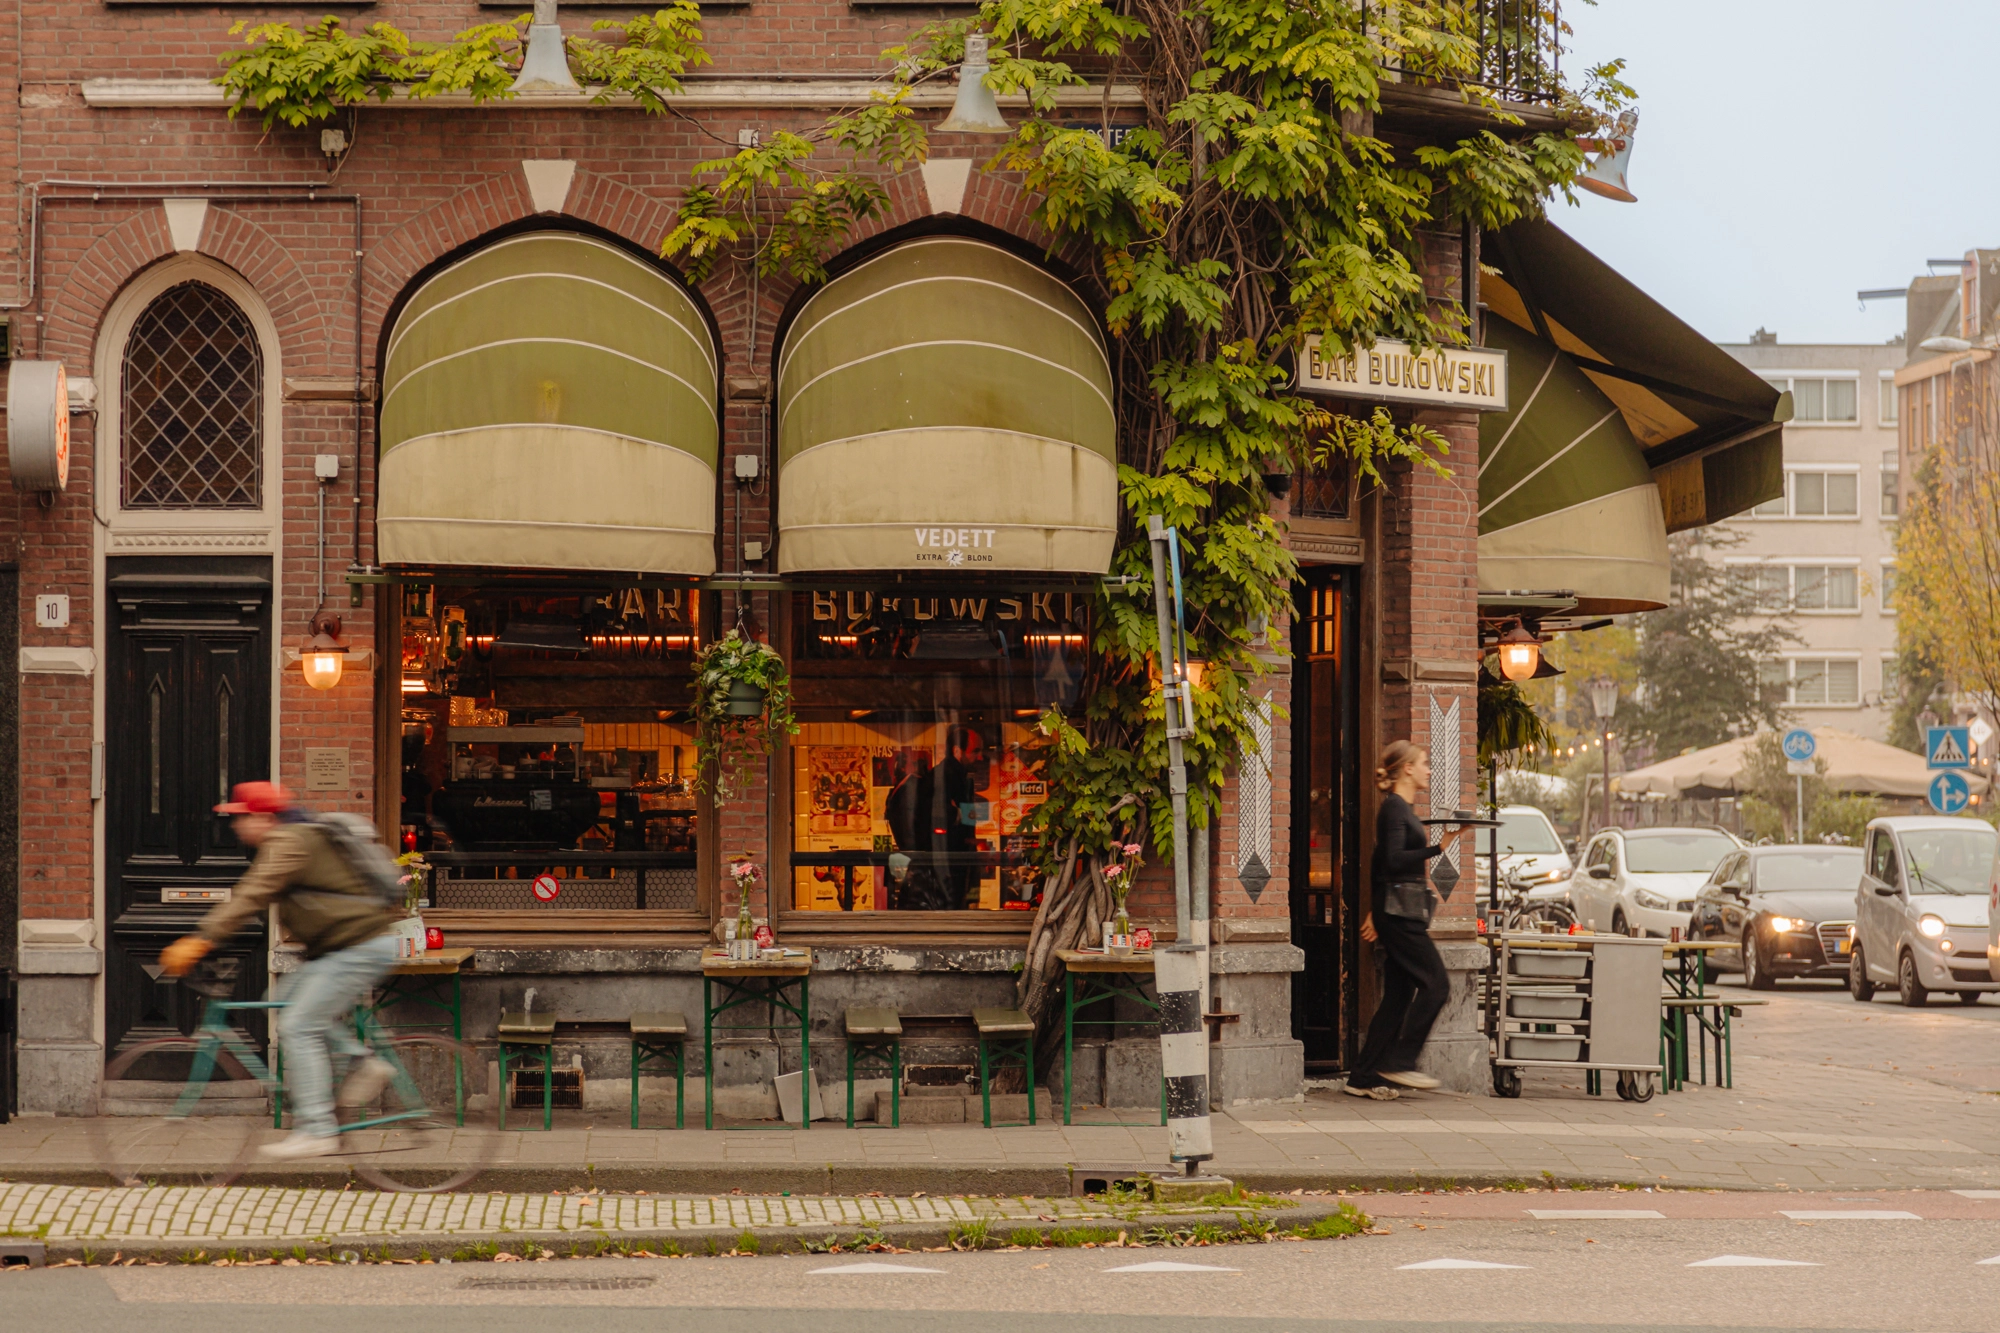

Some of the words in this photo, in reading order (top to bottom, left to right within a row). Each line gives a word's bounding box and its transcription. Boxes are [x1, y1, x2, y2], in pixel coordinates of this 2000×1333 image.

[1309, 345, 1358, 383] BAR
[1369, 351, 1495, 397] BUKOWSKI
[914, 528, 996, 548] VEDETT
[967, 554, 993, 562] BLOND
[46, 602, 58, 620] 10
[872, 745, 893, 758] AFAS
